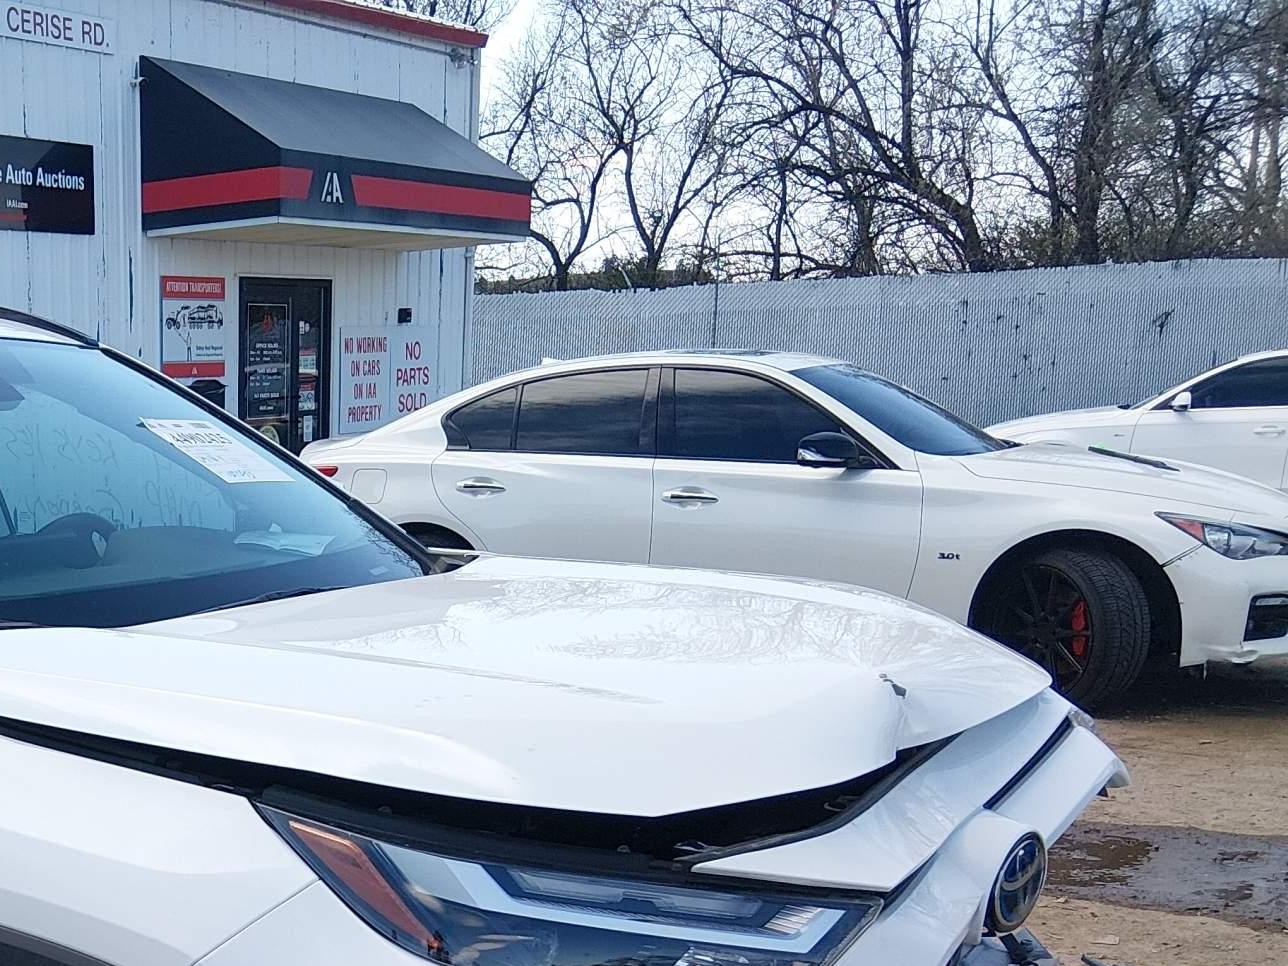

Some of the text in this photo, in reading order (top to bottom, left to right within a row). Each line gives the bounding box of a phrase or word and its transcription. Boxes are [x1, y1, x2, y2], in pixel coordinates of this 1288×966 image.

[6, 7, 74, 41] CERISE
[82, 21, 110, 47] RD.
[5, 163, 33, 186] Auto
[36, 167, 85, 191] Auctions
[344, 337, 387, 354] NO WORKING
[405, 341, 421, 360] NO
[351, 360, 381, 377] ON CARS
[396, 366, 430, 387] PARTS
[353, 382, 377, 400] ON IAA
[398, 392, 427, 413] SOLD
[348, 405, 382, 424] PROPERTY
